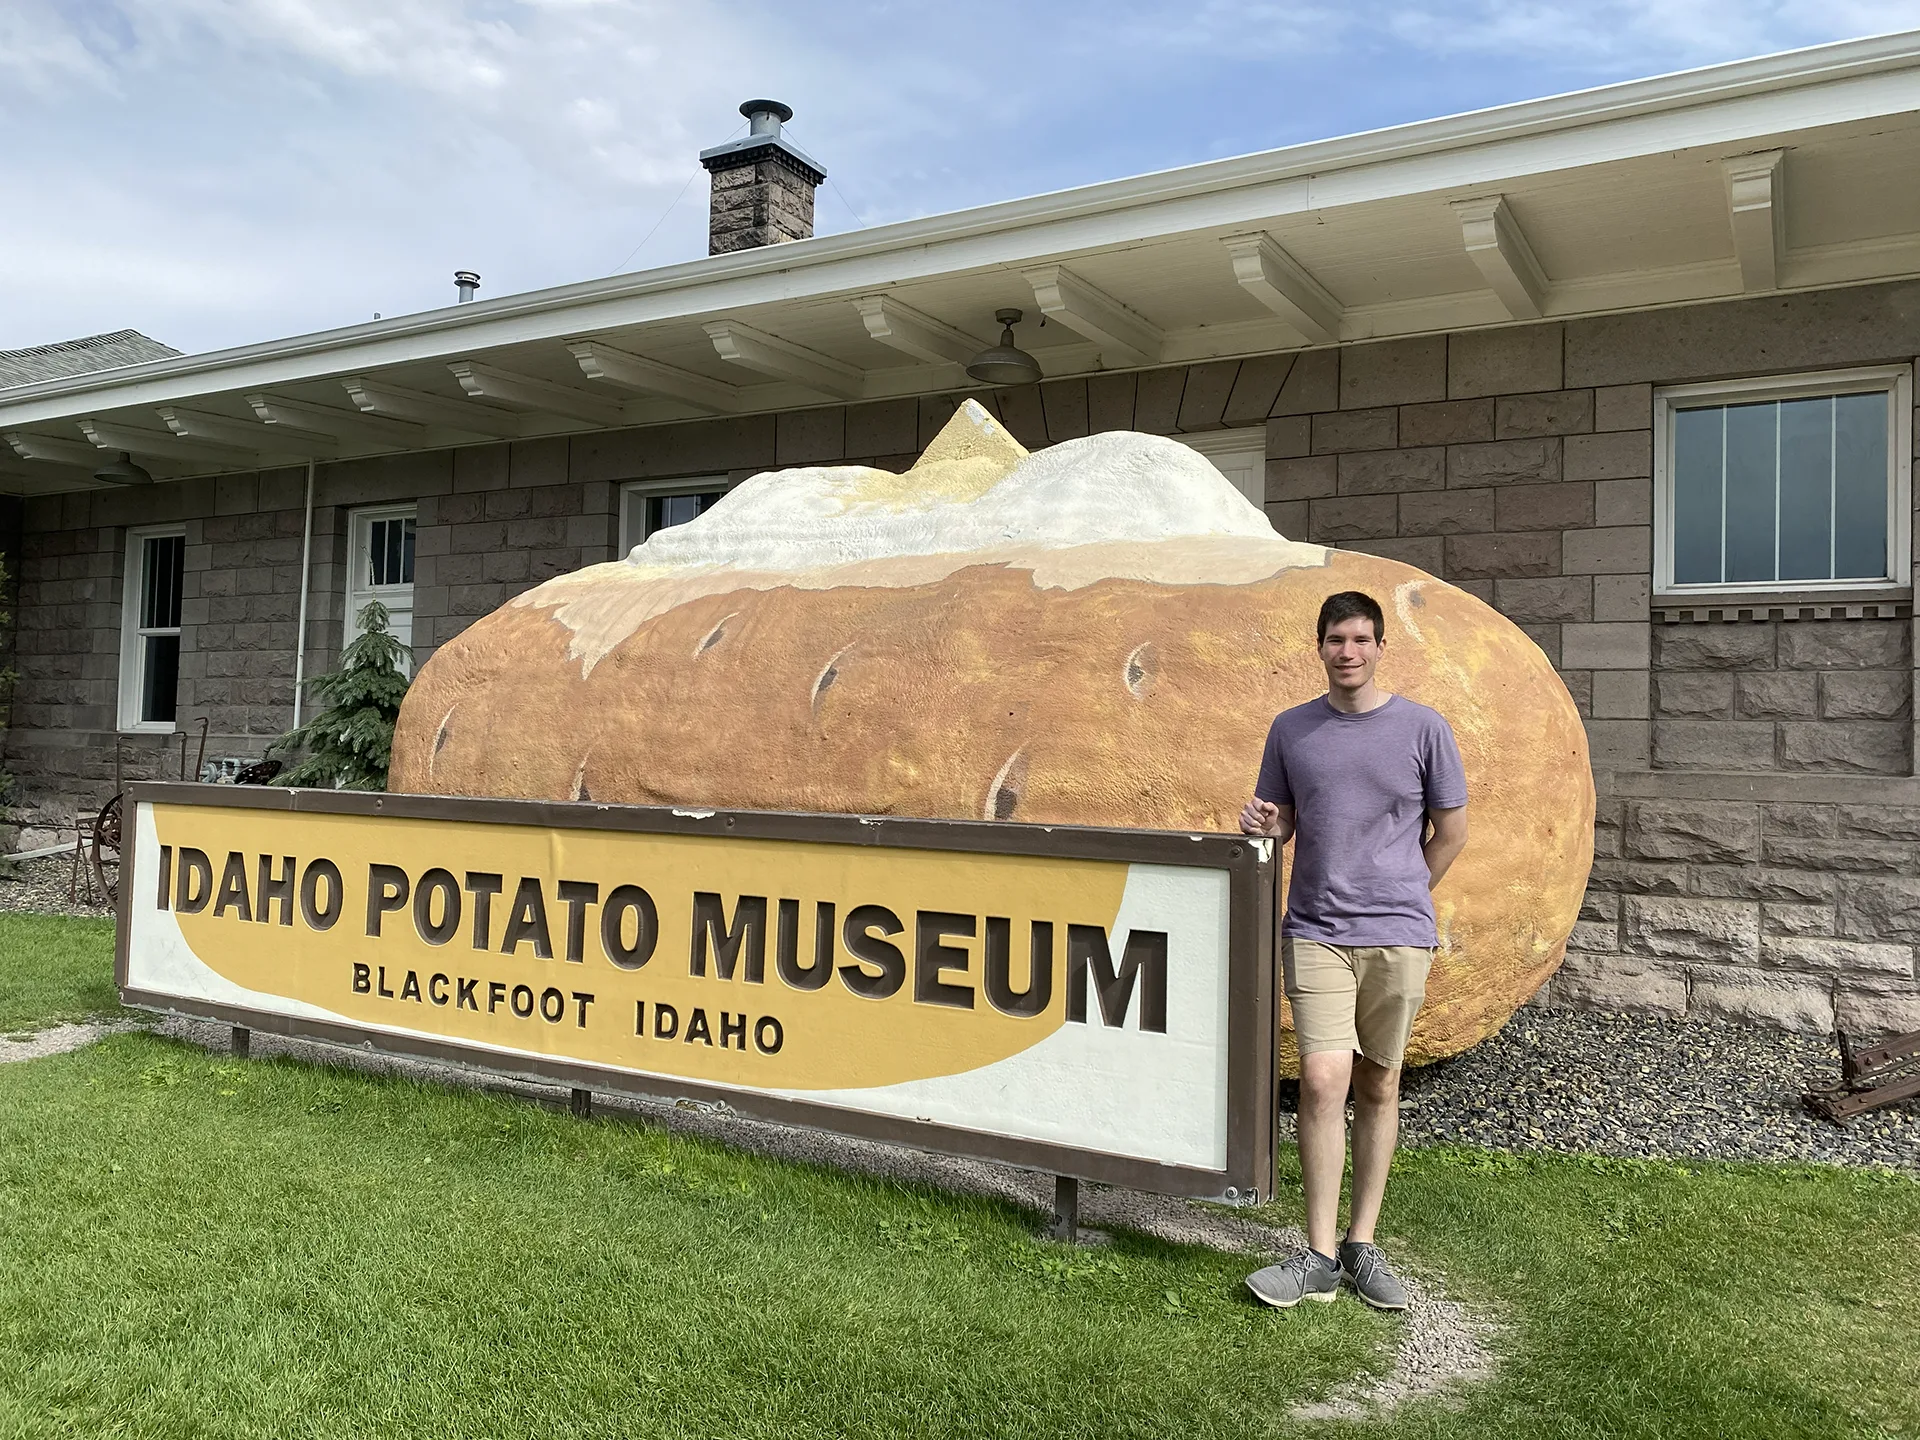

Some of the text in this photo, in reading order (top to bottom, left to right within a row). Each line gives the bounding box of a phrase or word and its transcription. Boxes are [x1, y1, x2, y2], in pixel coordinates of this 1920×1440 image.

[157, 844, 1169, 1035] IDAHO POTATO MUSEUM
[352, 962, 785, 1056] BLACKFOOT IDAHO
